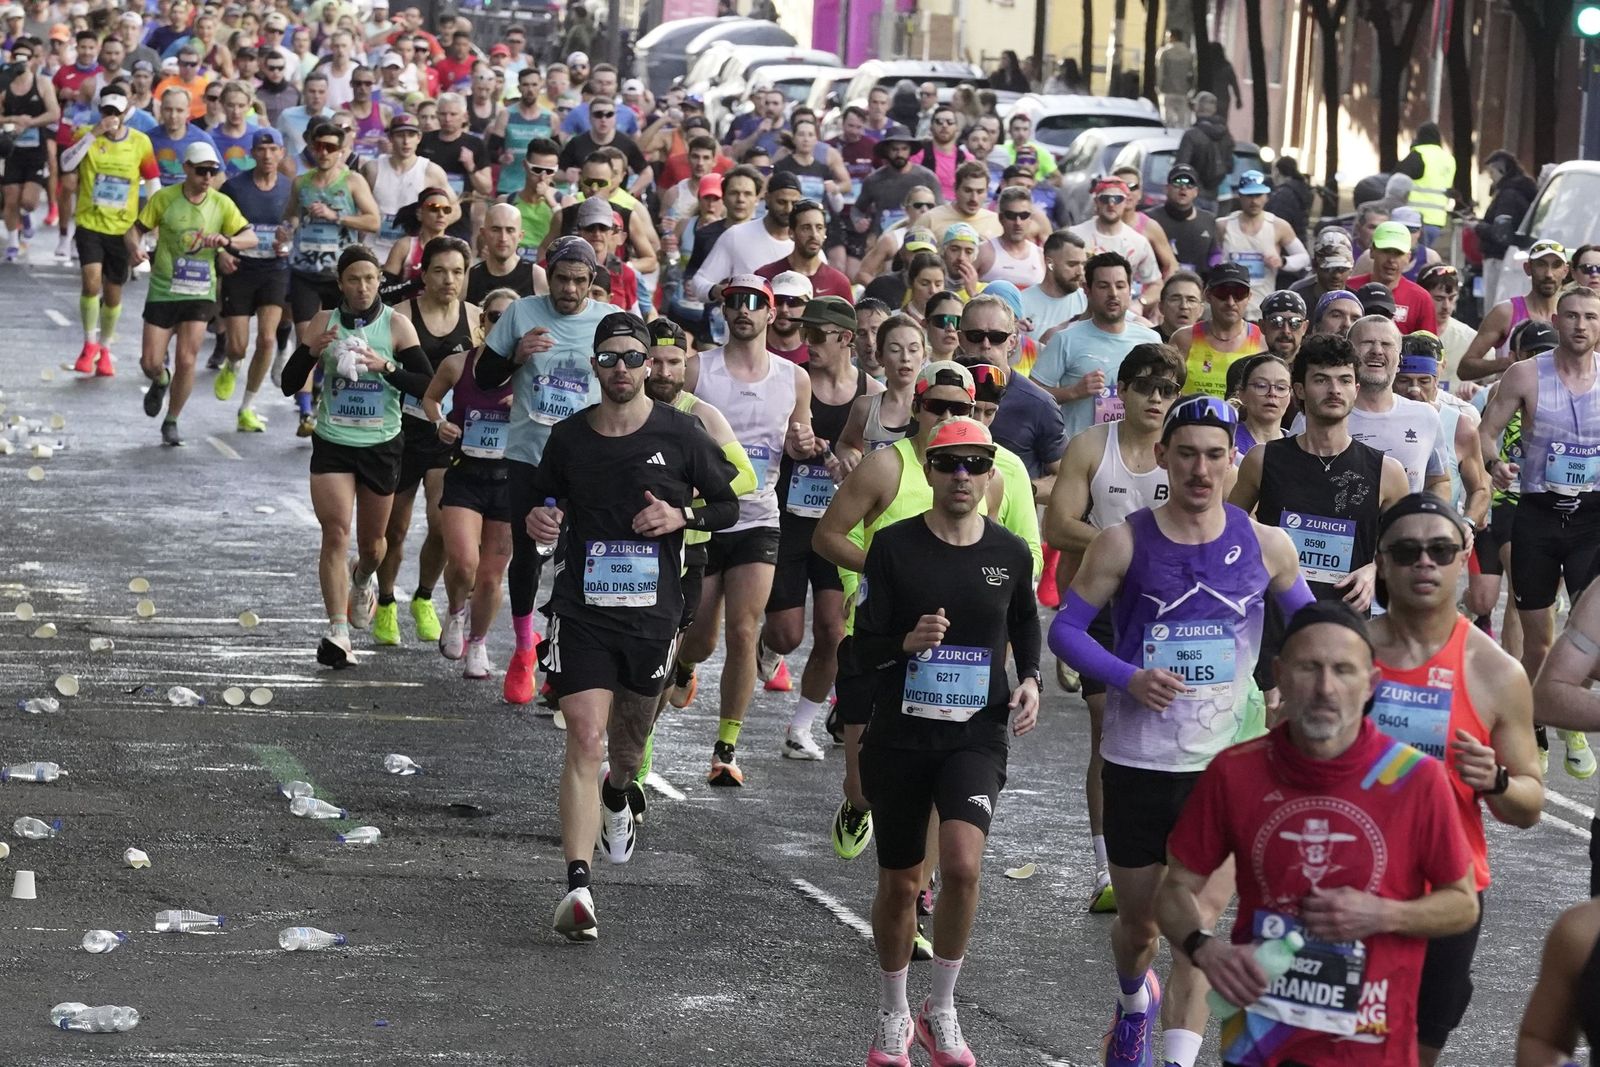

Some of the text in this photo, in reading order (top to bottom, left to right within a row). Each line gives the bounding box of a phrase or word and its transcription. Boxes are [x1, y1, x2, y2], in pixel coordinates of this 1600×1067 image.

[348, 382, 378, 390] ZURICH
[338, 404, 375, 416] JUANLU
[538, 401, 575, 416] JUANRA
[480, 436, 499, 448] KAT
[1569, 446, 1597, 456] ZURICH
[1568, 461, 1586, 470] 5895
[1566, 472, 1586, 484] TIM
[811, 484, 828, 492] 6144
[1305, 519, 1347, 532] ZURICH
[610, 544, 648, 554] ZURICH
[1304, 538, 1326, 550] 8590
[1299, 550, 1340, 568] ATTEO
[610, 564, 633, 573] 9262
[584, 580, 657, 592] JOÃO DIAS SMS
[1175, 625, 1223, 637] ZURICH
[937, 650, 982, 662] ZURICH
[1176, 650, 1202, 661] 9685
[936, 672, 960, 683] 6217
[904, 688, 986, 706] VICTOR SEGURA
[1381, 686, 1439, 705] ZURICH
[1378, 713, 1409, 728] 9404
[1291, 957, 1323, 976] 827
